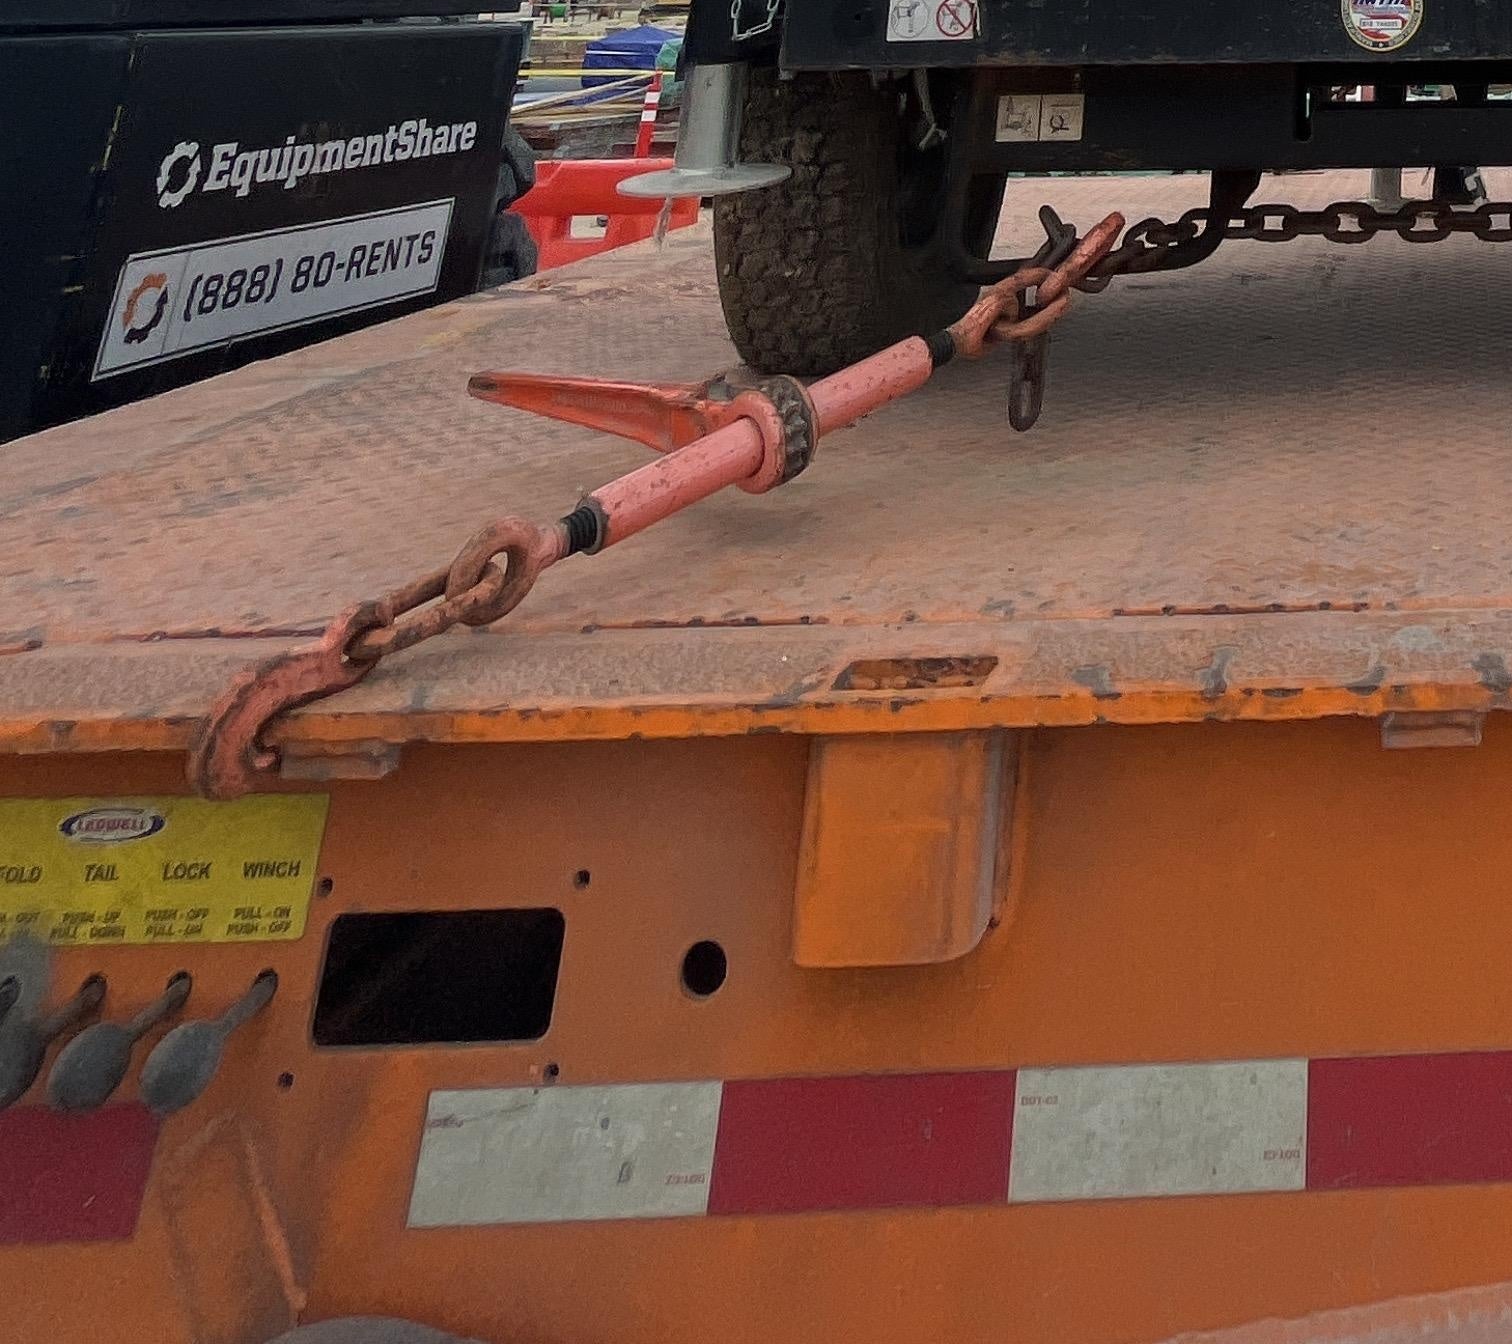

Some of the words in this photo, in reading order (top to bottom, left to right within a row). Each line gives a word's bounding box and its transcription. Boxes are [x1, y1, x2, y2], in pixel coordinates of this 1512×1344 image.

[202, 118, 478, 199] EquipmentShare
[183, 256, 284, 323] (888)
[290, 230, 437, 293] 80-RENTS
[84, 864, 119, 882] TAIL
[162, 862, 212, 881] LOCK
[242, 860, 301, 879] WINCH
